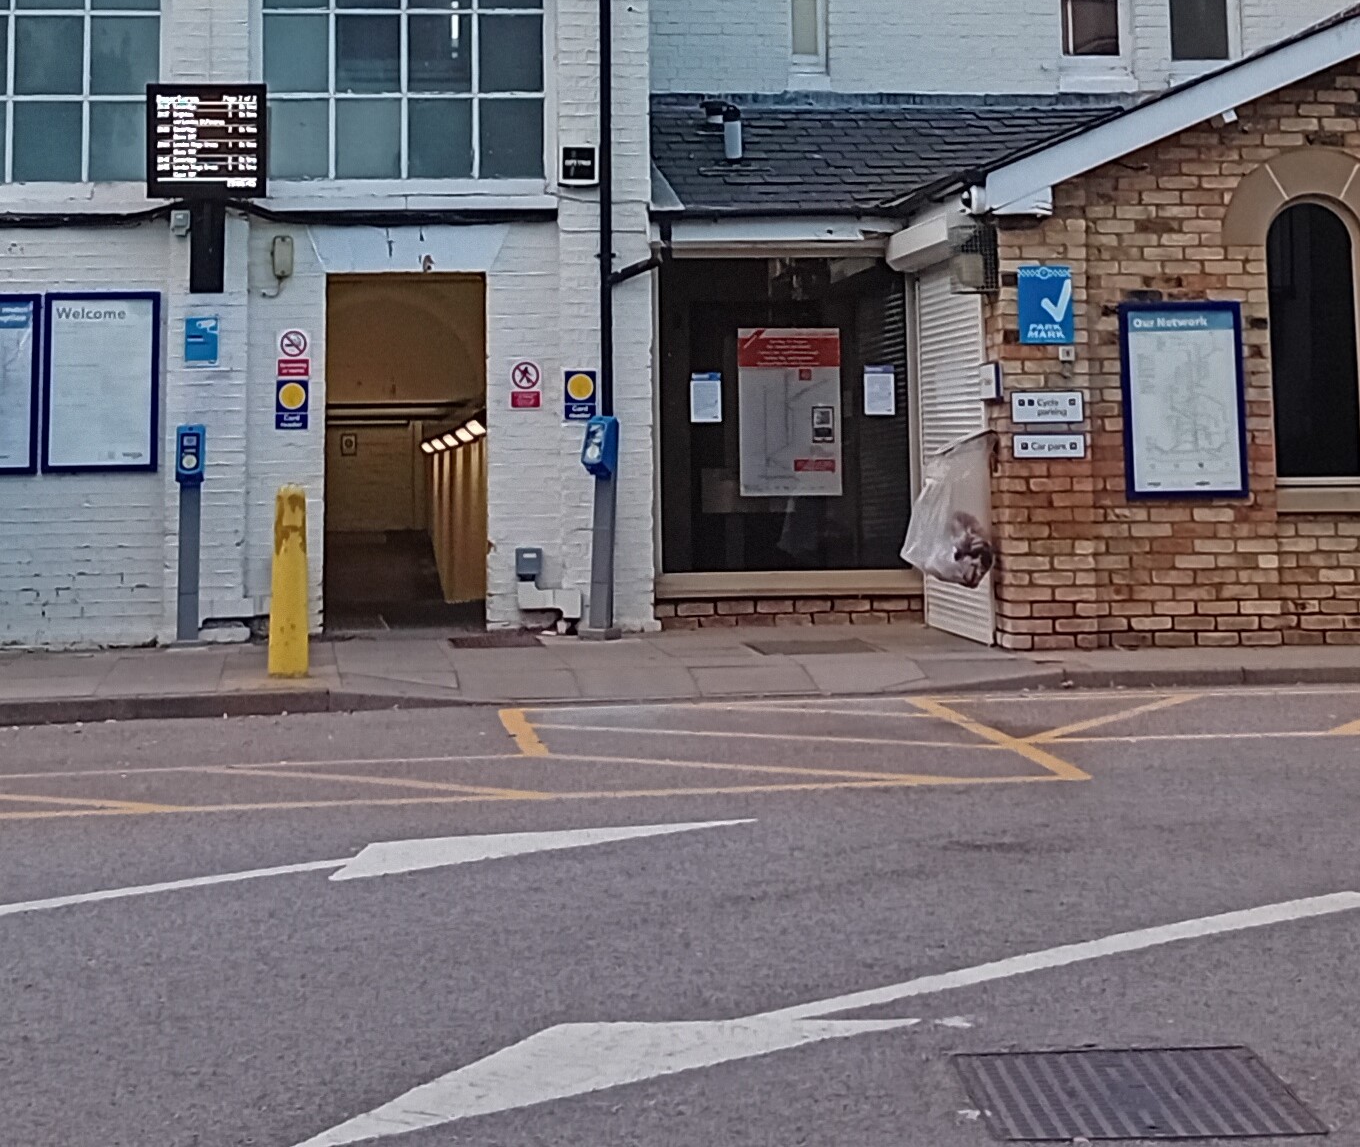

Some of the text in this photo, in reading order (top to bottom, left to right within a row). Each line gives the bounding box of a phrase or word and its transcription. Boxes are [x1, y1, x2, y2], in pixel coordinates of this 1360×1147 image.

[56, 306, 126, 320] Welcome
[1133, 315, 1208, 328] Our Network
[1029, 323, 1062, 332] PARK
[1027, 331, 1066, 339] MARK
[1031, 442, 1067, 452] Car park
